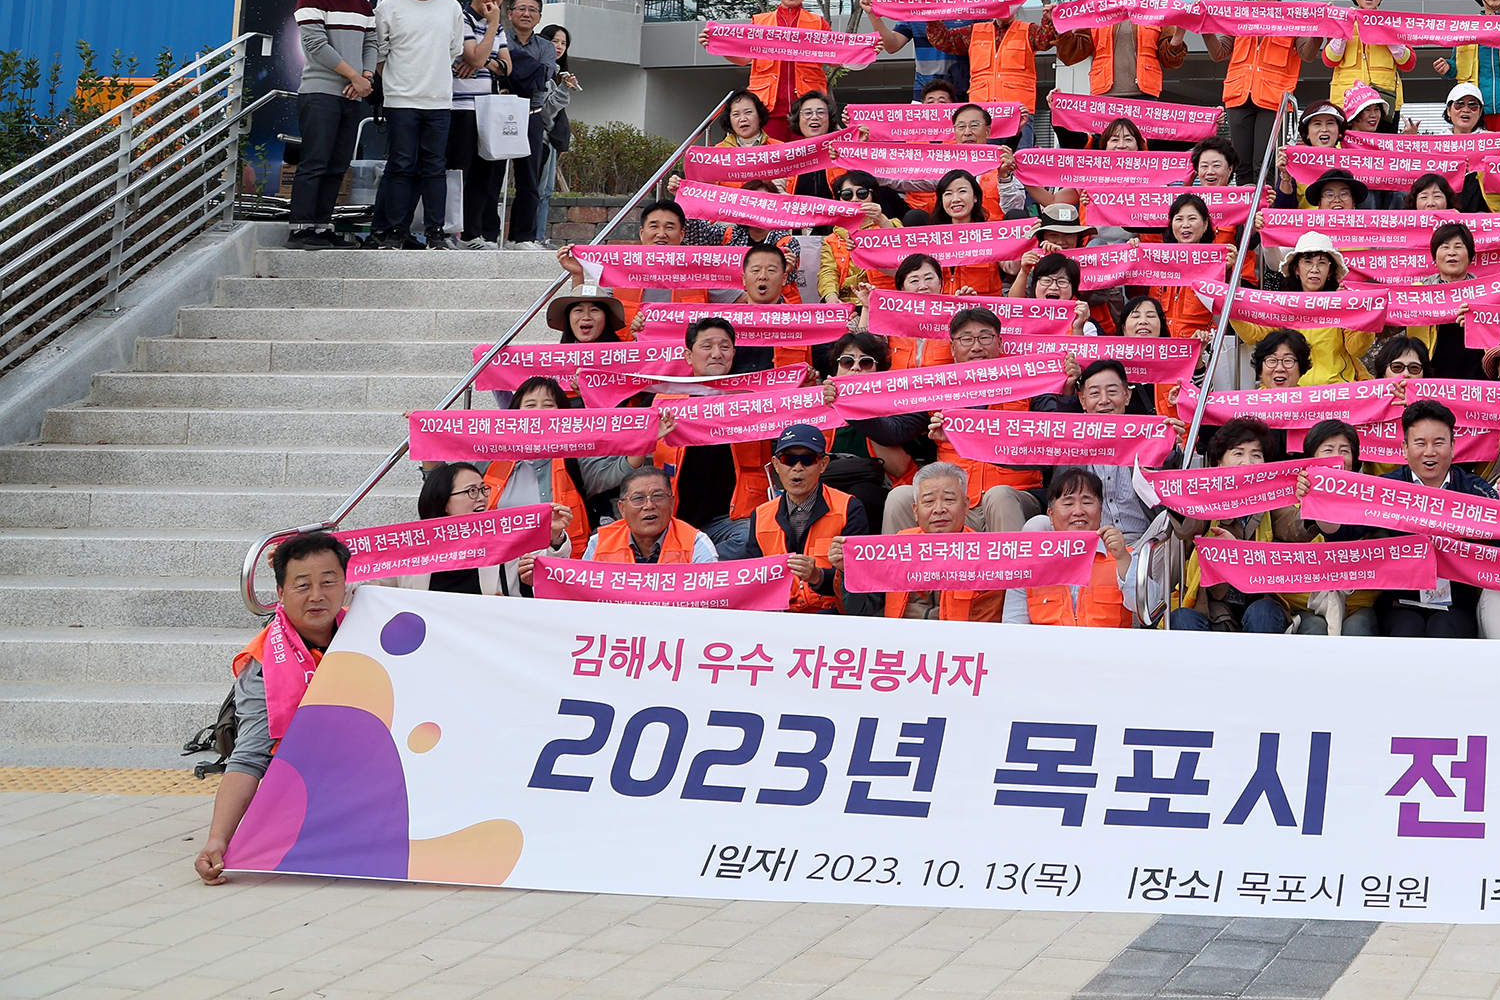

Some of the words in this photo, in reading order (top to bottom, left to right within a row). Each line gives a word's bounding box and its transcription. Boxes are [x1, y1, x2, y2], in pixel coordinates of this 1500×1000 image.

[1363, 14, 1402, 28] 2024년
[1404, 17, 1447, 31] 전국체전
[1449, 20, 1480, 32] 김해로
[712, 25, 745, 39] 2024년
[746, 27, 765, 40] 김해
[766, 26, 801, 44] 전국체전,
[801, 28, 847, 46] 자원봉사의
[847, 33, 876, 52] 힘으로!
[1020, 149, 1054, 167] 2024년
[1057, 154, 1075, 168] 김해
[1076, 155, 1113, 170] 전국체전,
[1115, 156, 1159, 170] 자원봉사의
[1161, 157, 1190, 171] 힘으로!
[682, 186, 718, 202] 2024년
[718, 191, 739, 205] 김해
[739, 194, 778, 213] 전국체전,
[780, 201, 826, 216] 자원봉사의
[838, 379, 882, 397] 2024년
[885, 375, 909, 392] 김해
[911, 370, 962, 389] 전국체전,
[963, 363, 1022, 383] 자원봉사의
[1023, 358, 1063, 377] 힘으로!
[1414, 382, 1457, 401] 2024년
[1460, 385, 1483, 402] 김해
[419, 417, 463, 435] 2024년
[467, 417, 491, 435] 김해
[494, 417, 544, 435] 전국체전,
[547, 415, 607, 434] 자원봉사의
[611, 414, 650, 432] 힘으로!
[944, 416, 1000, 436] 2024년
[1005, 418, 1067, 439] 전국체전
[1071, 421, 1117, 440] 김해로
[1120, 422, 1167, 440] 오세요
[1313, 474, 1375, 502] 2024년
[1380, 487, 1445, 516] 전국체전
[1450, 501, 1498, 525] 김해로
[346, 535, 372, 556] 김해
[373, 528, 430, 552] 전국체전,
[432, 518, 497, 542] 자원봉사의
[499, 512, 541, 534] 힘으로!
[853, 542, 913, 562] 2024년
[917, 541, 981, 561] 전국체전
[986, 540, 1033, 560] 김해로
[1037, 539, 1087, 558] 오세요
[545, 566, 605, 589] 2024년
[609, 571, 676, 592] 전국체전
[682, 570, 730, 591] 김해로
[734, 564, 785, 586] 오세요
[571, 634, 685, 681] 김해시
[698, 643, 774, 686] 우수
[787, 646, 988, 696] 자원봉사자
[527, 698, 947, 818] 2023년
[994, 721, 1331, 835] 목포시
[806, 854, 901, 885] 2023.
[923, 860, 963, 888] 10.
[986, 863, 1081, 896] 13(목)
[1237, 872, 1344, 906] 목포시
[1361, 876, 1429, 908] 일원
